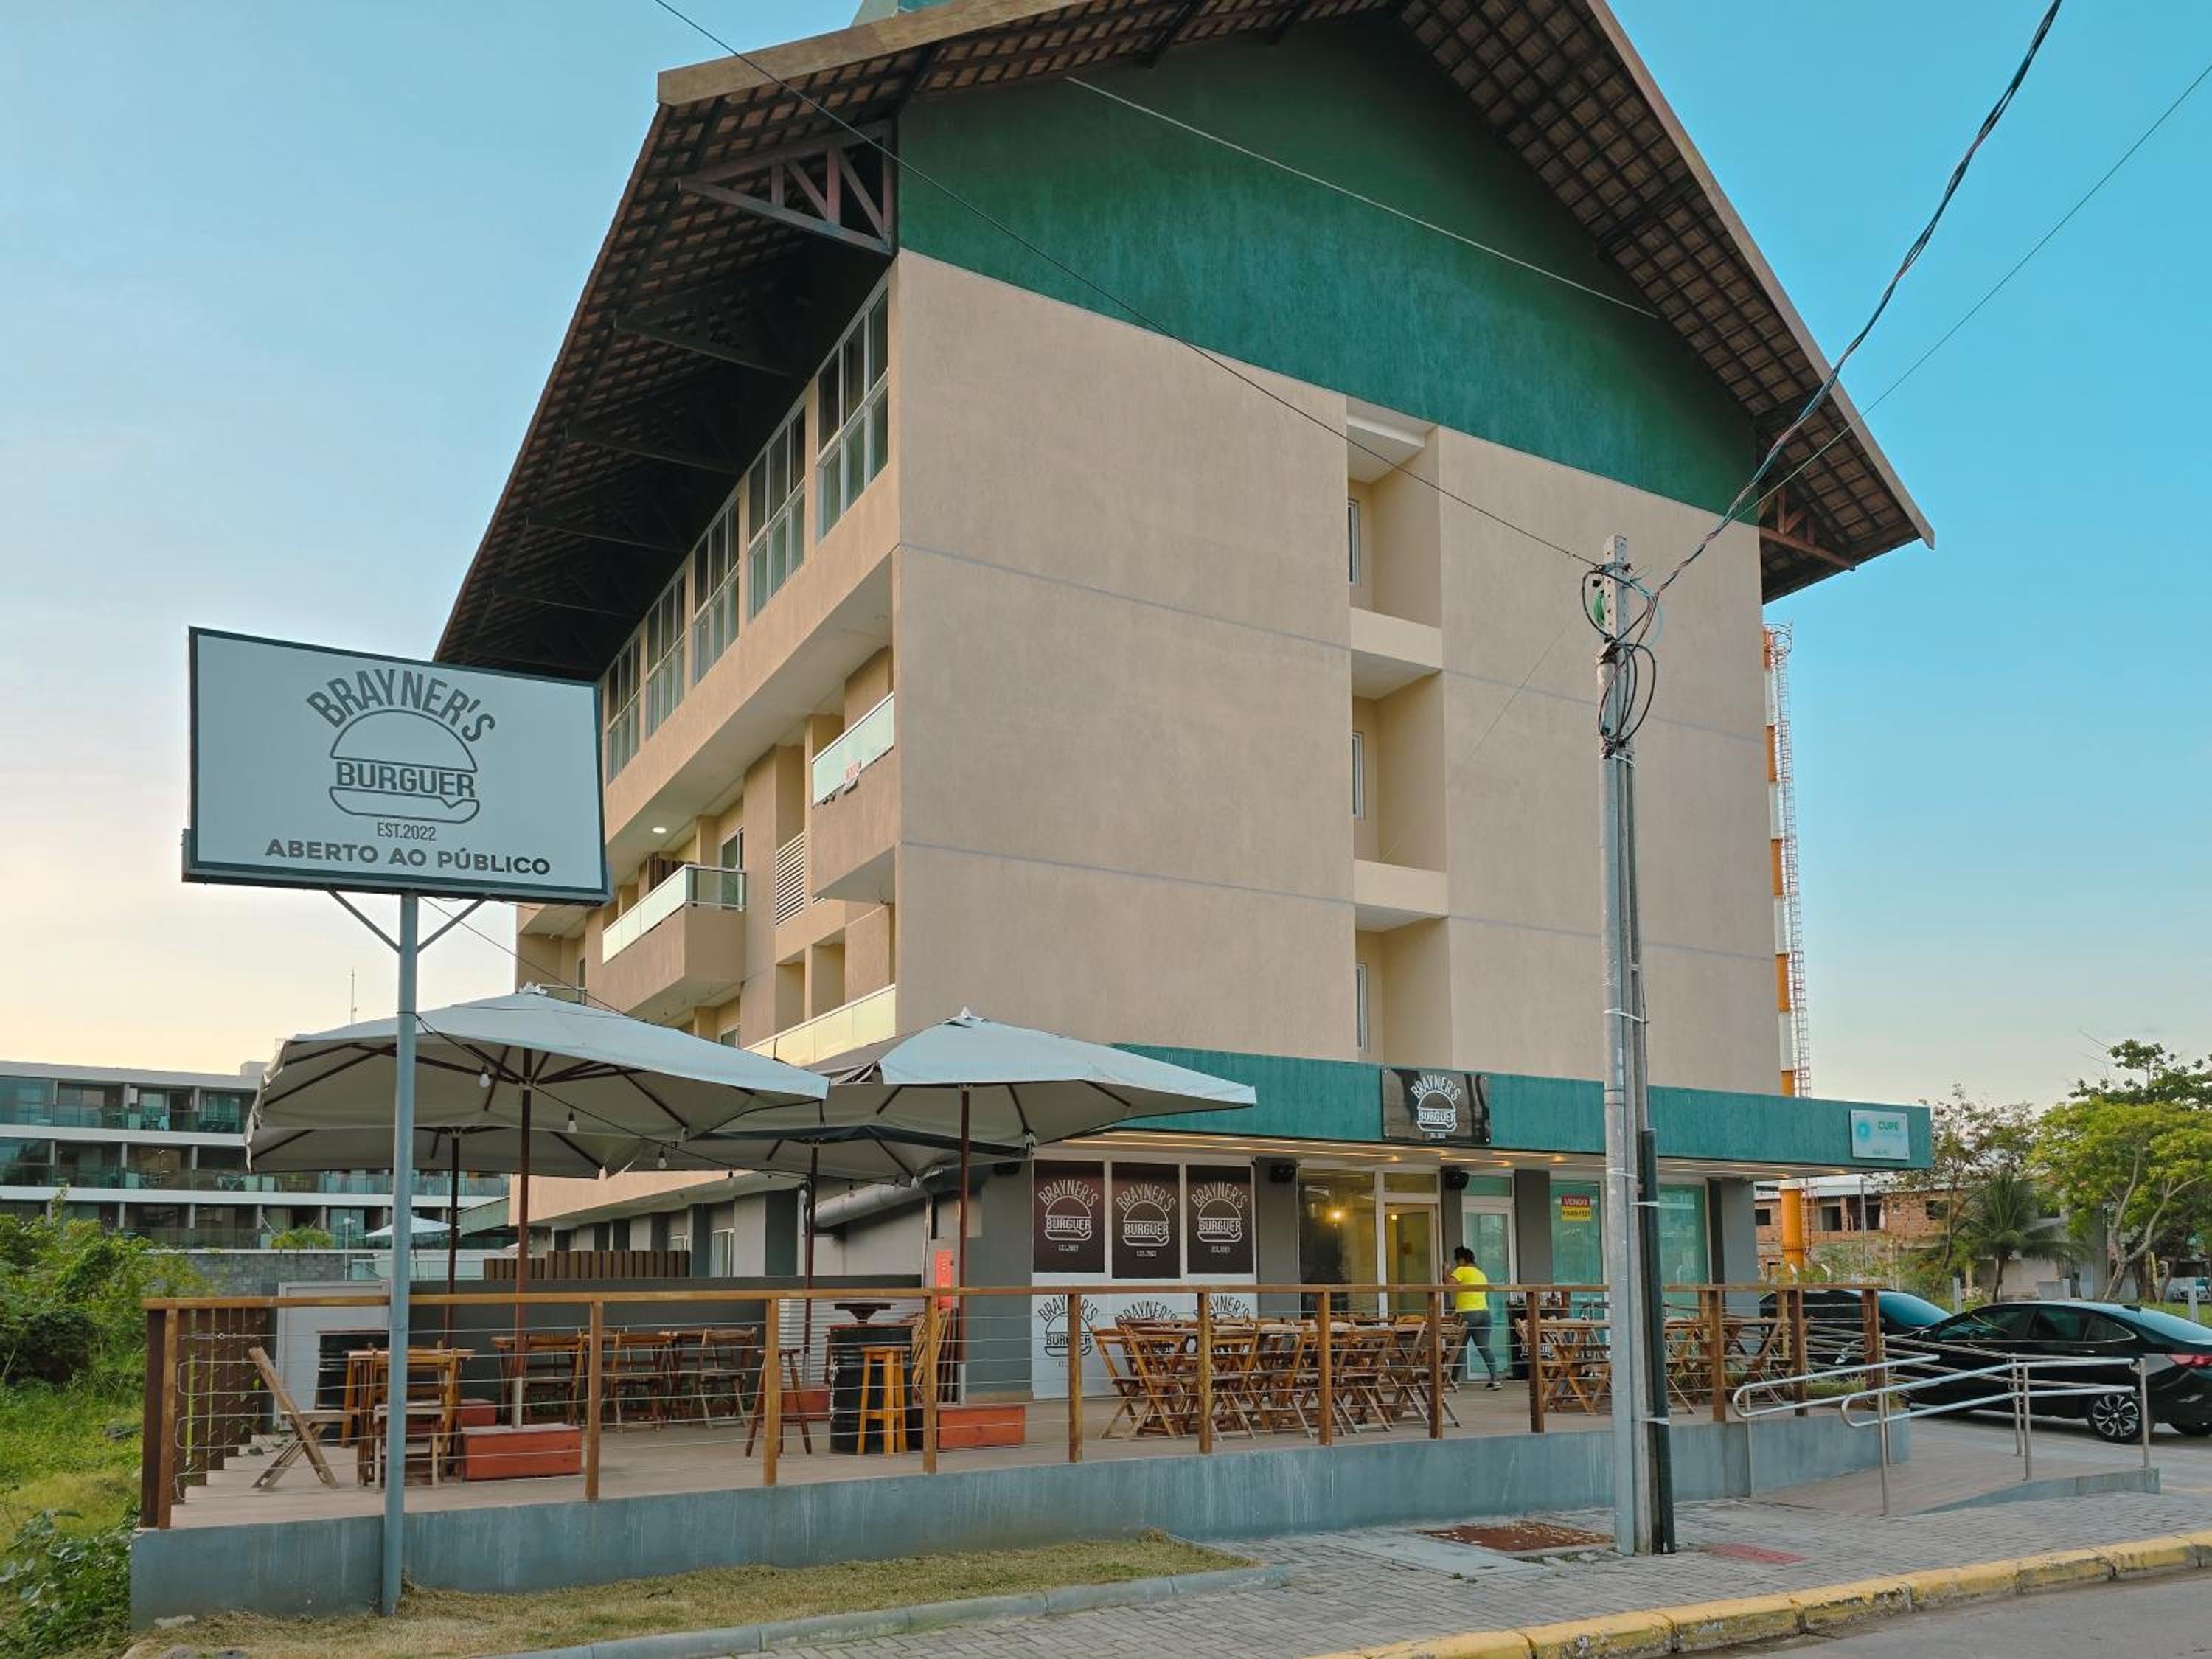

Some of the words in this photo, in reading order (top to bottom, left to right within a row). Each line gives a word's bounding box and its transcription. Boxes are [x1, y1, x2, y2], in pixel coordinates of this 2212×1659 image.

[305, 668, 496, 742] BRAYNER'S
[335, 761, 476, 799] BURGUER
[377, 822, 437, 841] EST.2022
[265, 838, 379, 863] ABERTO
[389, 847, 428, 866] AO
[437, 847, 552, 875] PÚBLICO
[1410, 1074, 1461, 1101] BRAYNER'S
[1418, 1110, 1456, 1121] BURGUER
[1038, 1180, 1099, 1207] BRAYNER'S
[1116, 1183, 1176, 1212] BRAYNER'S
[1191, 1181, 1248, 1208] BRAYNER'S
[1046, 1217, 1091, 1231] BURGUER
[1124, 1223, 1169, 1235] BURGUER
[1198, 1220, 1241, 1232] BURGUER
[1037, 1295, 1098, 1322] BRAYR'S
